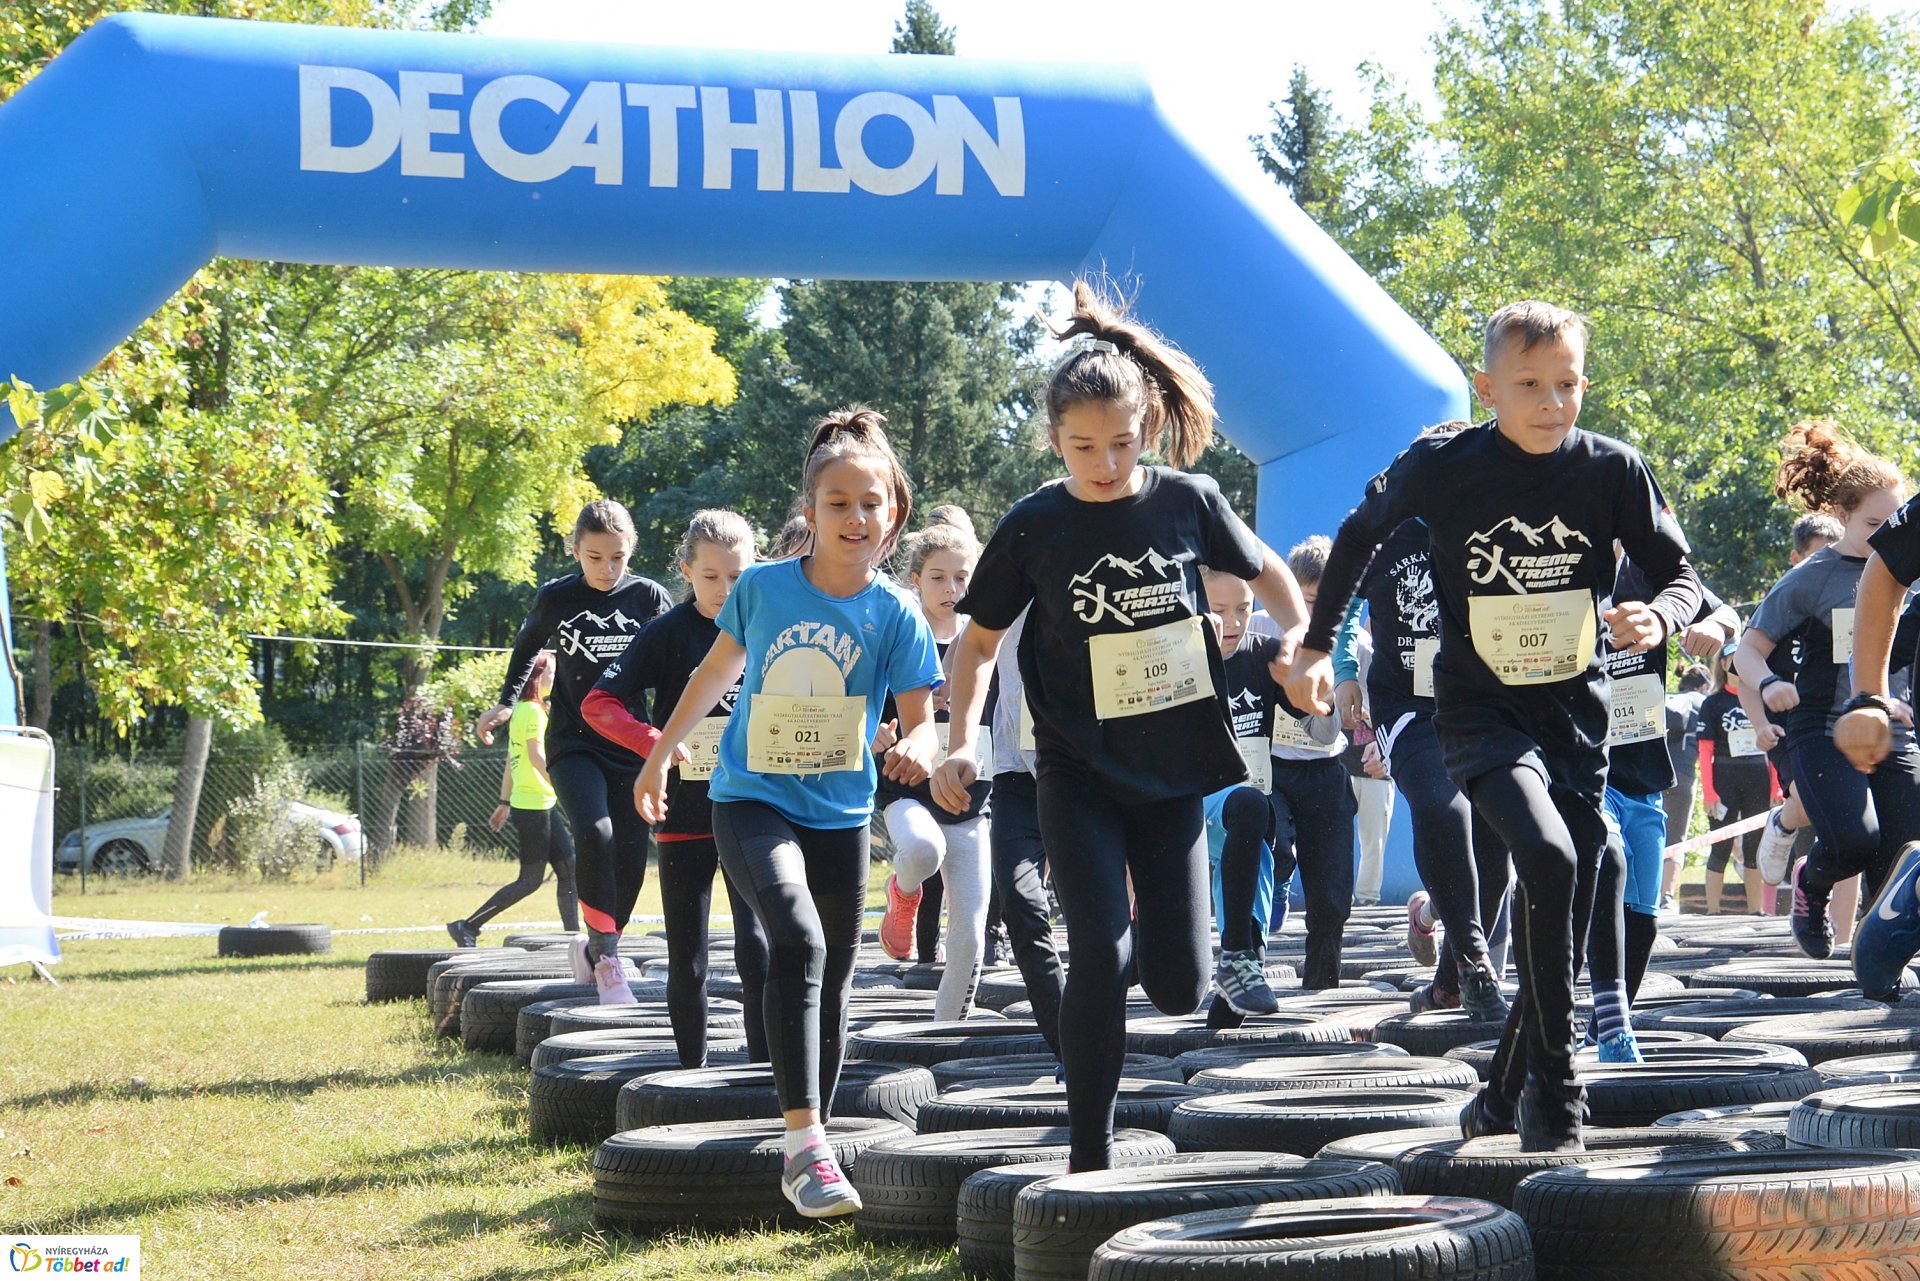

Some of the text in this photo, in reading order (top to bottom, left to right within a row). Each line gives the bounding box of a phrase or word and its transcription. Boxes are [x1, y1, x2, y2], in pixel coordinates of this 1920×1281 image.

[299, 64, 1026, 197] DECATHLON
[1390, 551, 1431, 577] SÁRKÁ
[1515, 565, 1574, 579] TRAIL
[1120, 594, 1179, 612] TRAIL
[761, 620, 863, 679] SPARTAN
[1519, 633, 1548, 648] 007
[1144, 662, 1168, 680] 109
[1614, 705, 1635, 718] 014
[794, 730, 821, 743] 021
